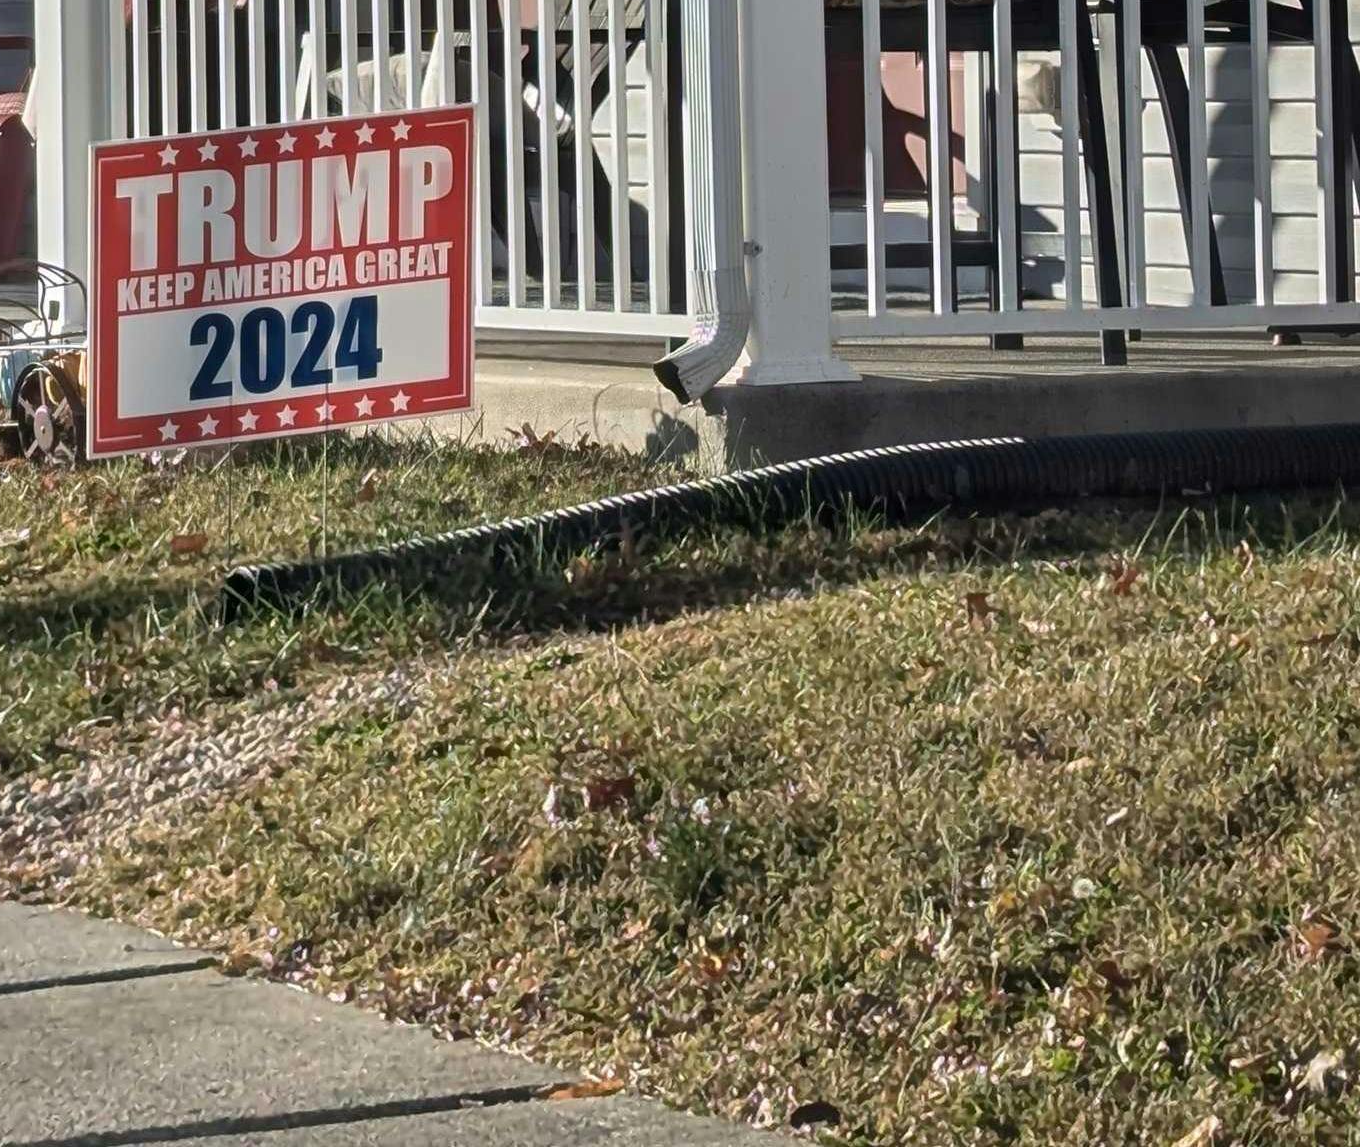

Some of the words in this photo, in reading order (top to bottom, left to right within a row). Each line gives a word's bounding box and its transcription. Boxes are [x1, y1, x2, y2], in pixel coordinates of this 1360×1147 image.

[115, 145, 454, 272] TRUMP
[117, 271, 196, 312] KEEP
[201, 254, 348, 303] AMERICA
[354, 242, 454, 284] GREAT
[189, 294, 383, 402] 2024
